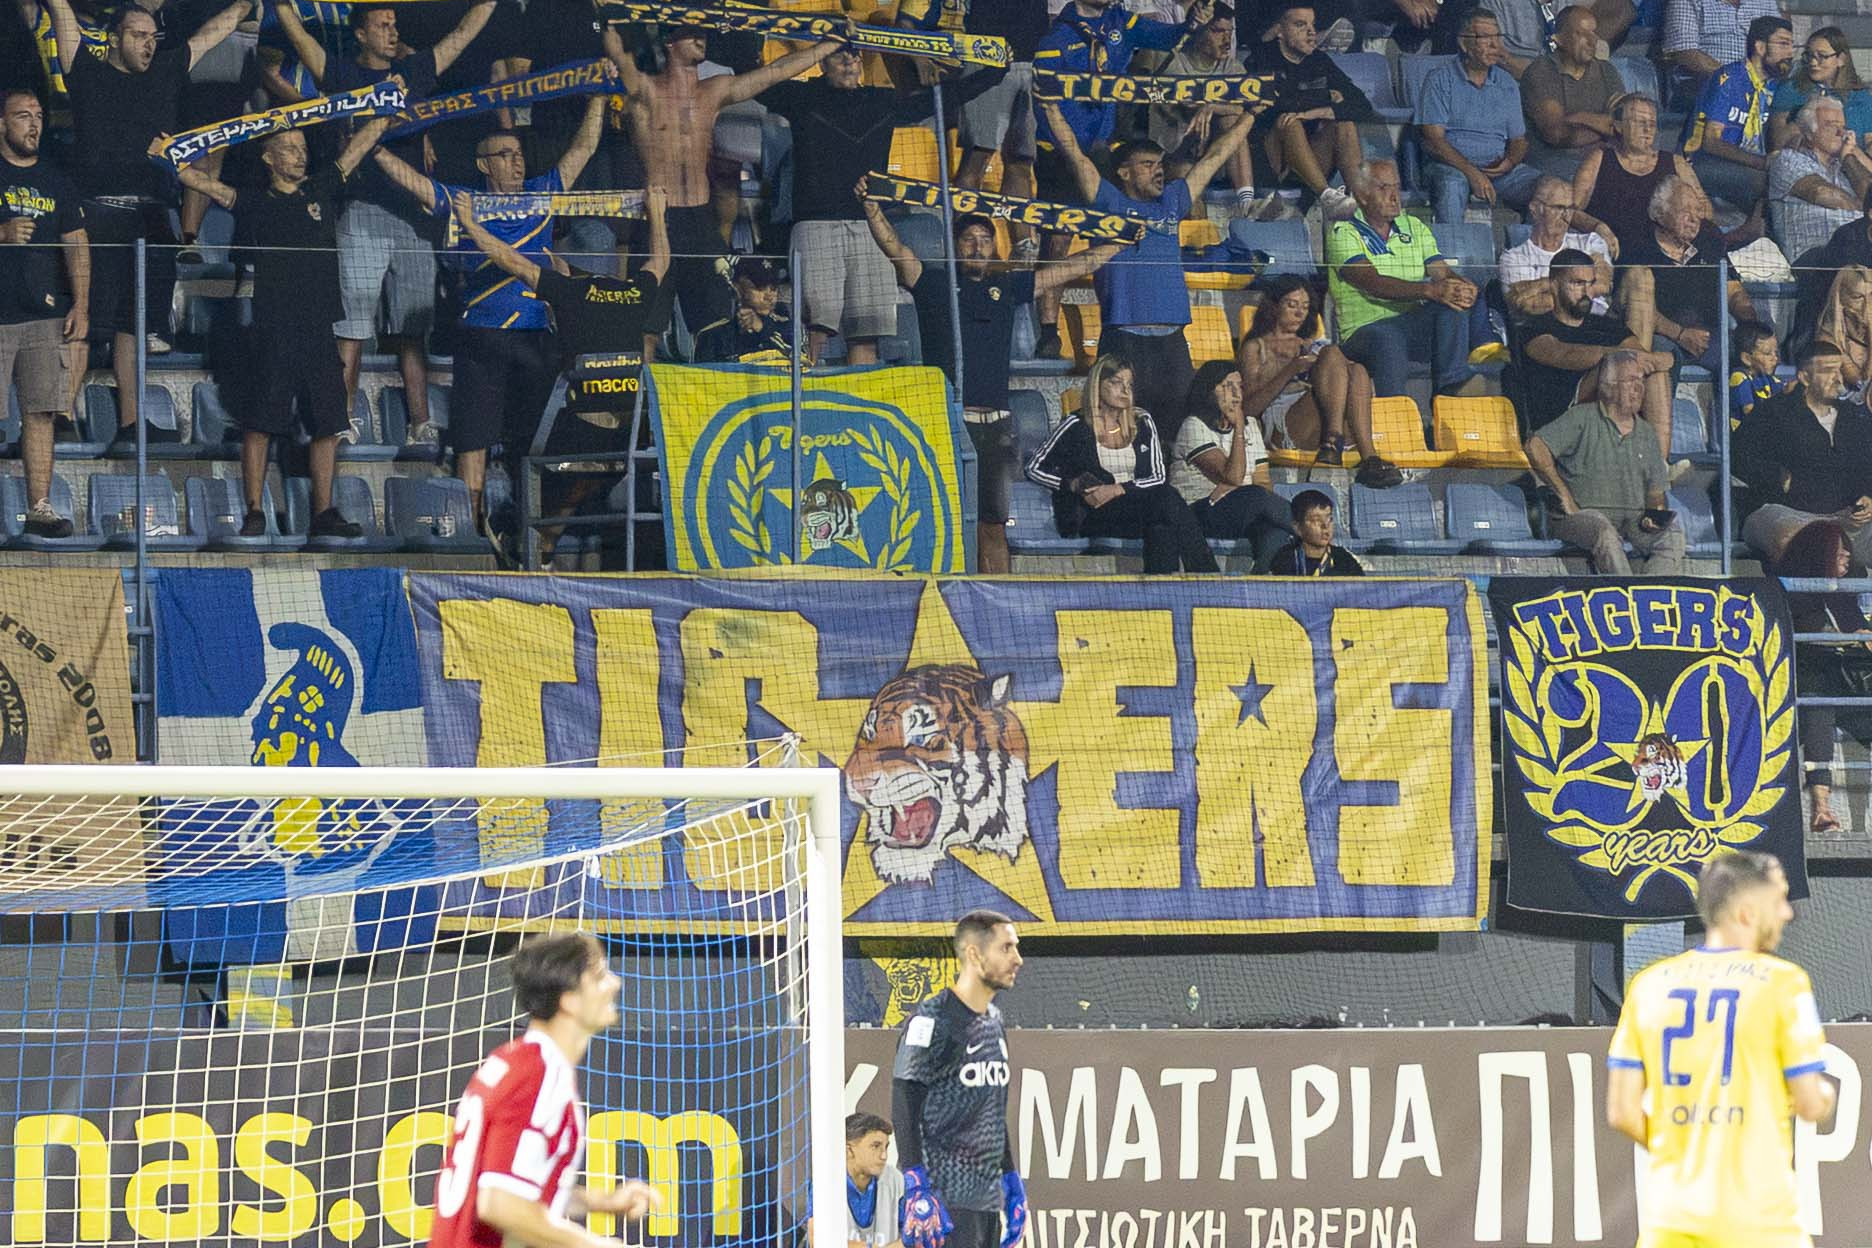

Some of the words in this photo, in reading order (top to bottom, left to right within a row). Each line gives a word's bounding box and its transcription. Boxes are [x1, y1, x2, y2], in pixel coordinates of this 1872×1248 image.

[412, 92, 473, 120] ΕΡΑΣ
[1058, 73, 1263, 102] TIGERS
[894, 179, 1128, 238] TIGERS
[768, 426, 854, 456] Tgers
[1512, 585, 1766, 664] TIGERS
[439, 596, 1456, 893] TIGERS
[1536, 655, 1766, 831] 20
[1603, 827, 1718, 876] years
[1663, 988, 1741, 1087] 27
